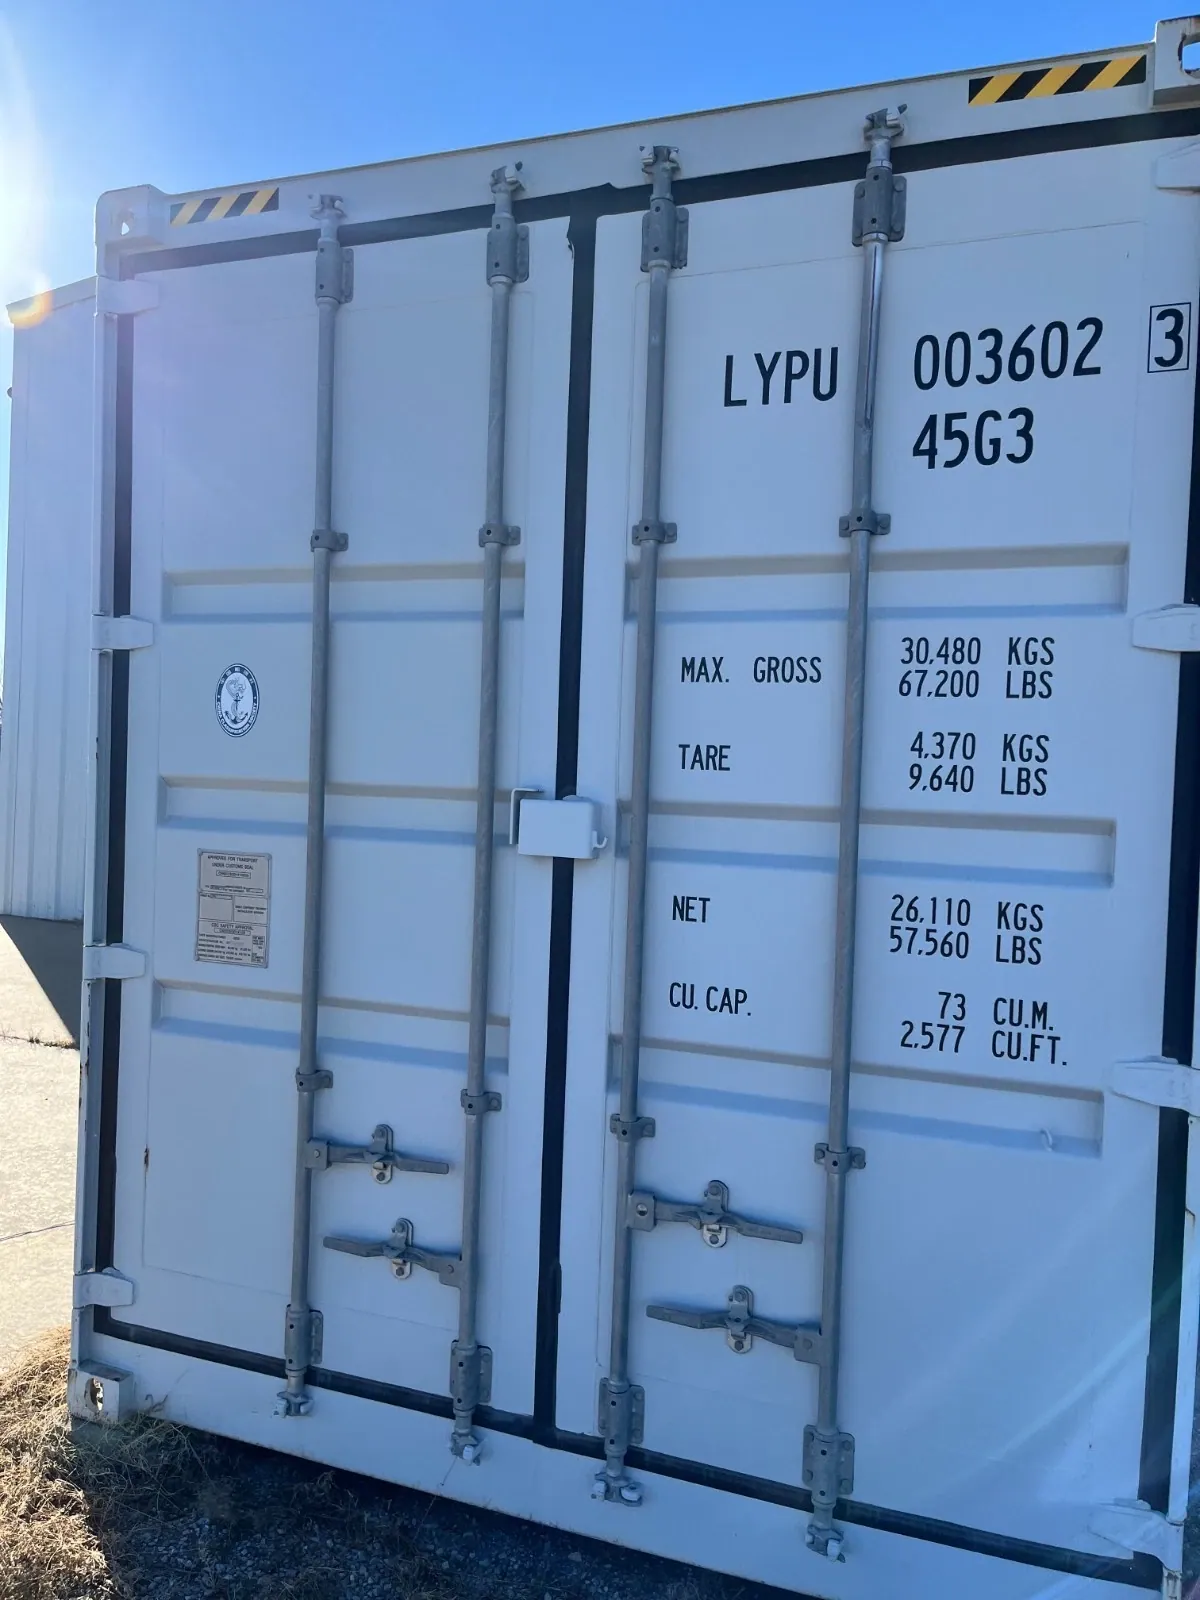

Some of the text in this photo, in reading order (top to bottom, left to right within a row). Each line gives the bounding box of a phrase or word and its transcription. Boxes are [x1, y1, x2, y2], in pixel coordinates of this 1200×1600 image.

[724, 309, 1184, 407] LYPU 003602 3
[913, 408, 1033, 469] 45G3
[900, 637, 1055, 665] 30,480 KGS
[681, 657, 822, 683] MAX. GROSS
[899, 670, 1053, 699] 67,200 LBS
[679, 744, 731, 772] TARE
[910, 732, 1050, 763] 4,370 KGS
[909, 764, 1048, 796] 9,640 LBS
[673, 896, 711, 923] NET
[891, 895, 1044, 932] 26,110 KGS
[890, 926, 1042, 965] 57,560 LBS
[669, 982, 752, 1016] CU. CAP.
[939, 992, 1054, 1031] 73 CU.M.
[900, 1021, 1067, 1066] 2,577 CU.FT.
